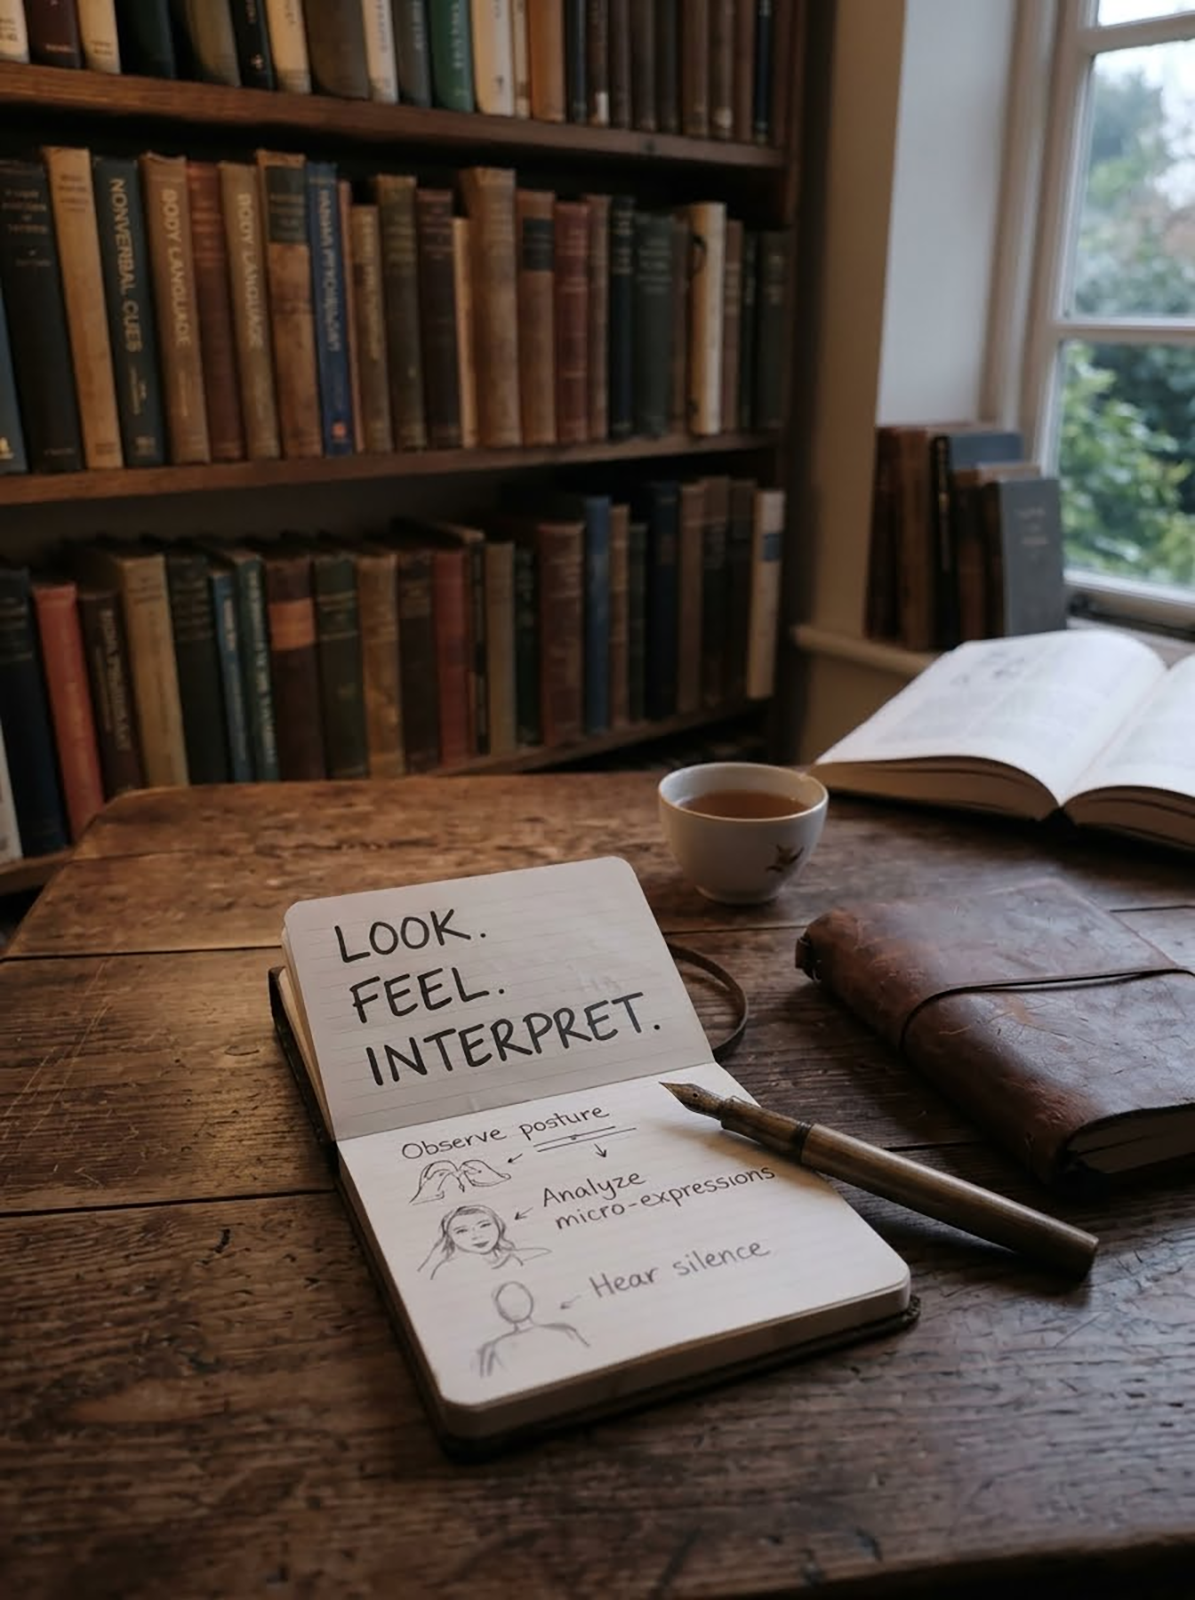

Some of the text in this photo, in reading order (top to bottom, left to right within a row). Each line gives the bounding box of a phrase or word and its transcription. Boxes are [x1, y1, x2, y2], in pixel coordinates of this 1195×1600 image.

[161, 188, 181, 242] BODY
[110, 178, 136, 295] NONVERBAL
[123, 300, 142, 352] CUES
[334, 908, 487, 963] LOOK.
[349, 966, 505, 1024] FEEL.
[366, 992, 661, 1086] INTERPRET.
[401, 1105, 610, 1160] Observe posture
[543, 1172, 646, 1207] Analyze
[555, 1166, 776, 1230] micro-expressions
[589, 1241, 771, 1298] Hear silence
